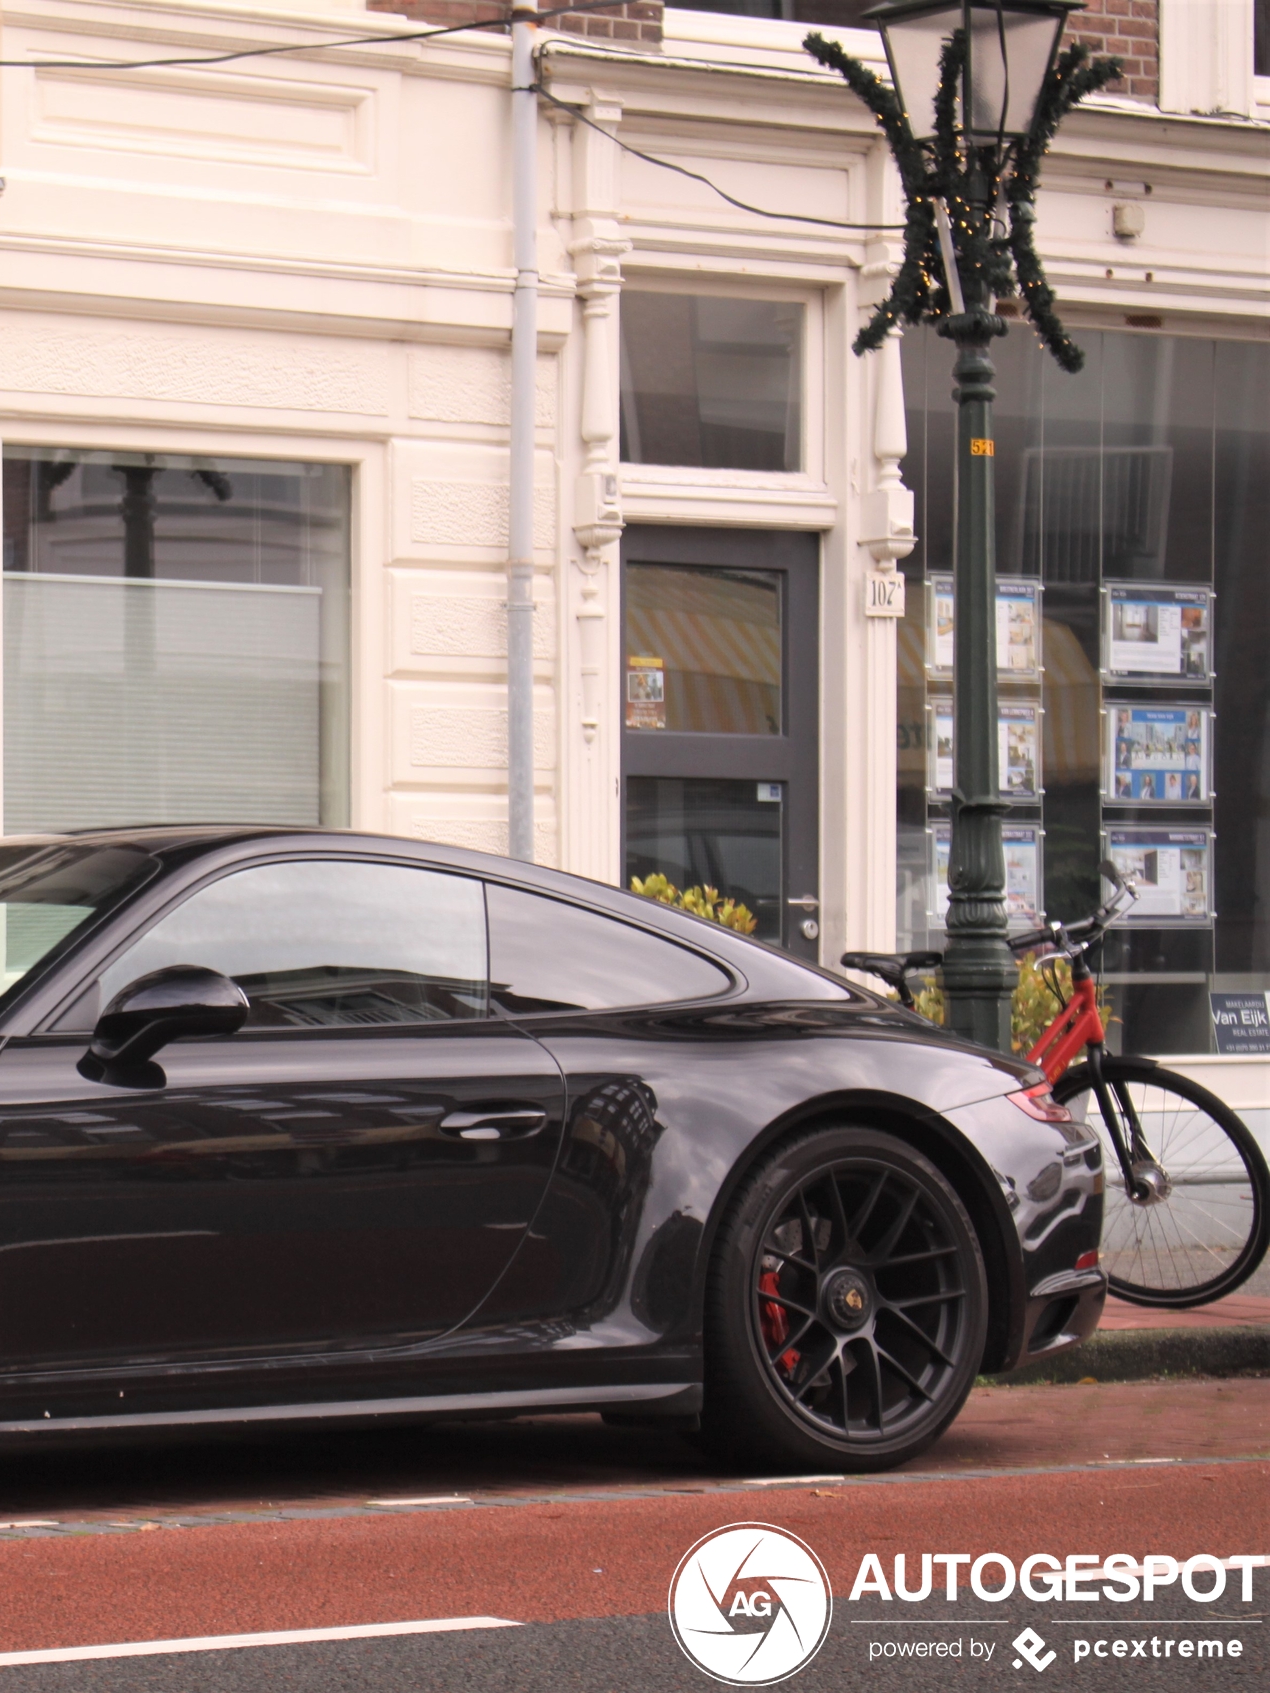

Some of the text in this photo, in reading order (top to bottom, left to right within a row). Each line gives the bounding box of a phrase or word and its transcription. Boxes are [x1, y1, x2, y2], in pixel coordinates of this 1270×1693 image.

[1212, 1009, 1268, 1028] Van Eijk
[1232, 1028, 1270, 1037] REAL ESTATE
